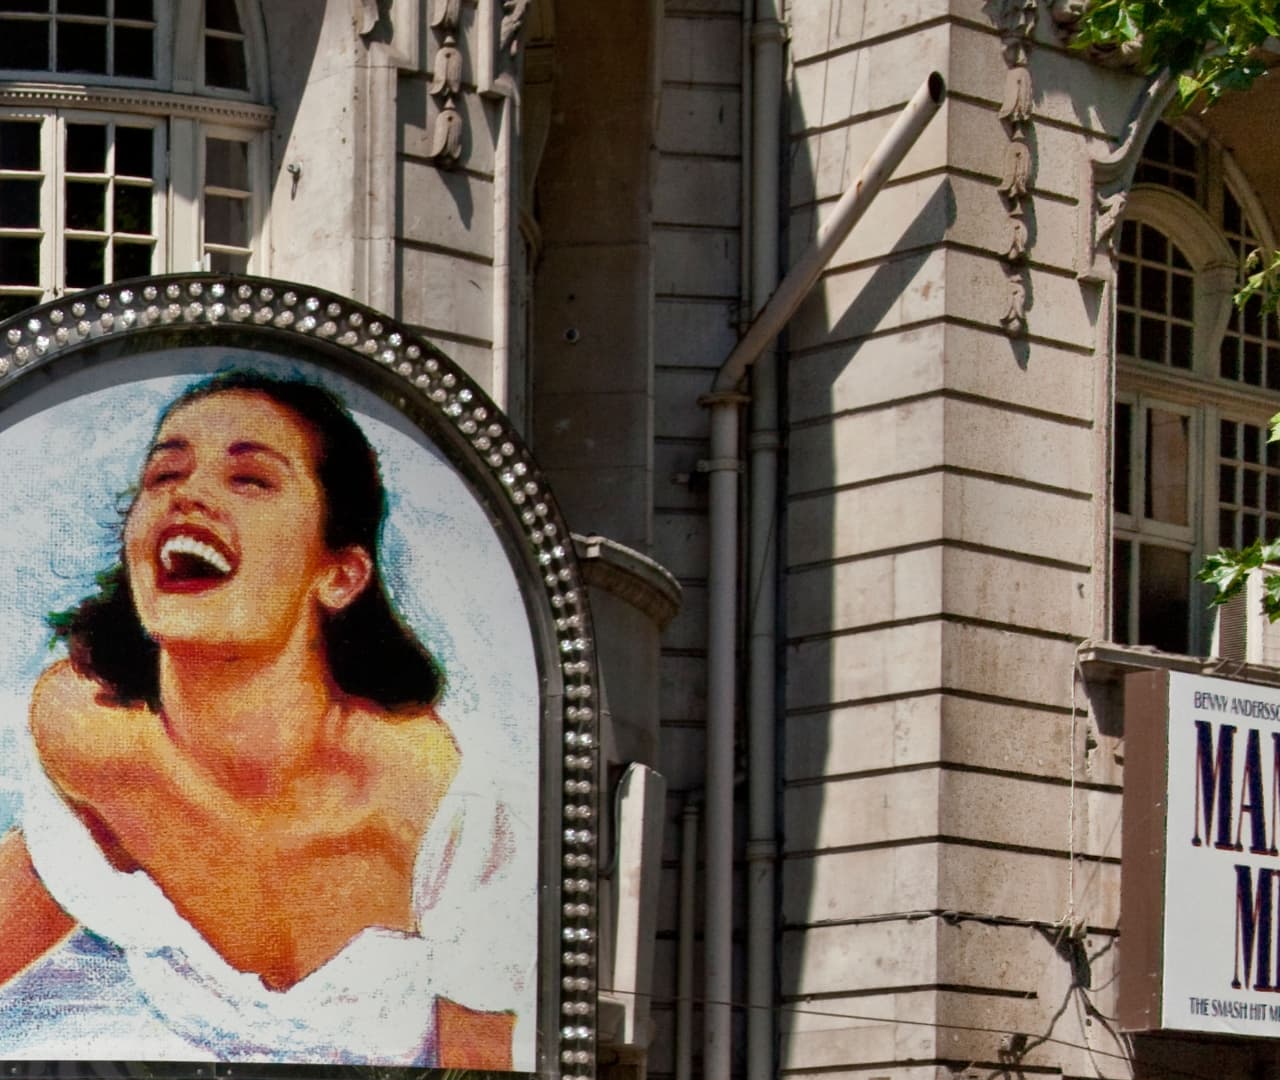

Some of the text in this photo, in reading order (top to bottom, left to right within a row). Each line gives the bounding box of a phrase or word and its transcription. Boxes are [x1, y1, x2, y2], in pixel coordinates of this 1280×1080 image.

[1194, 691, 1228, 712] BENNY
[1192, 719, 1280, 857] MA
[1189, 997, 1210, 1017] THE
[1211, 999, 1248, 1021] SMASH
[1249, 1003, 1267, 1022] HIT
